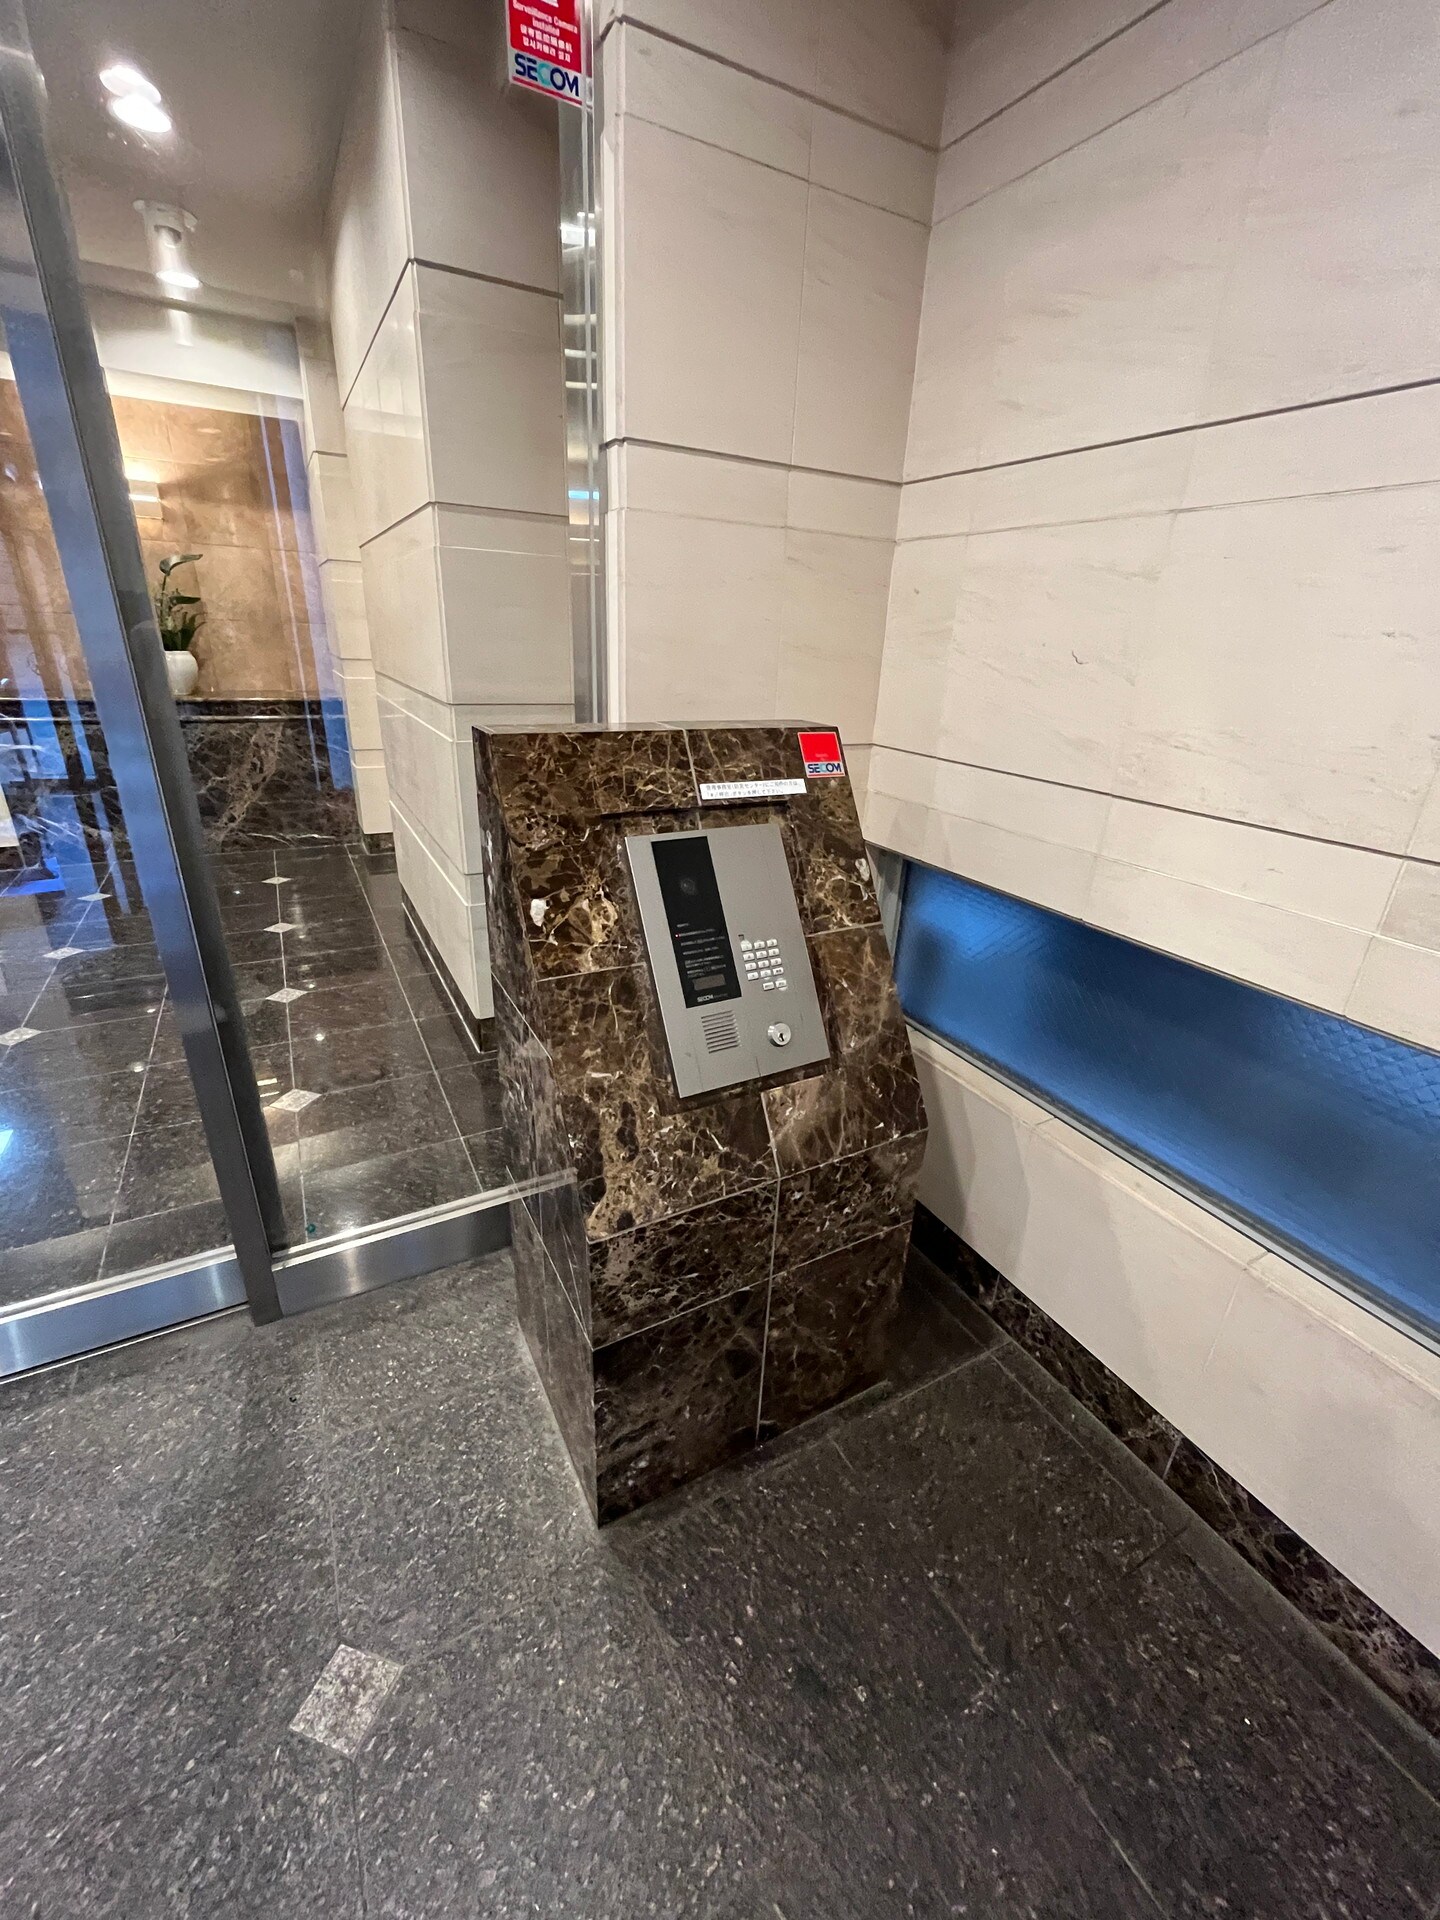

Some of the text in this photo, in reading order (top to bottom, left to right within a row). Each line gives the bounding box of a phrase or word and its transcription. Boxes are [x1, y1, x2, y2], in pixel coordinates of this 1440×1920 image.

[532, 17, 560, 36] Installed
[554, 16, 578, 34] Camera
[514, 52, 579, 97] SECOM
[807, 762, 842, 773] SECOM
